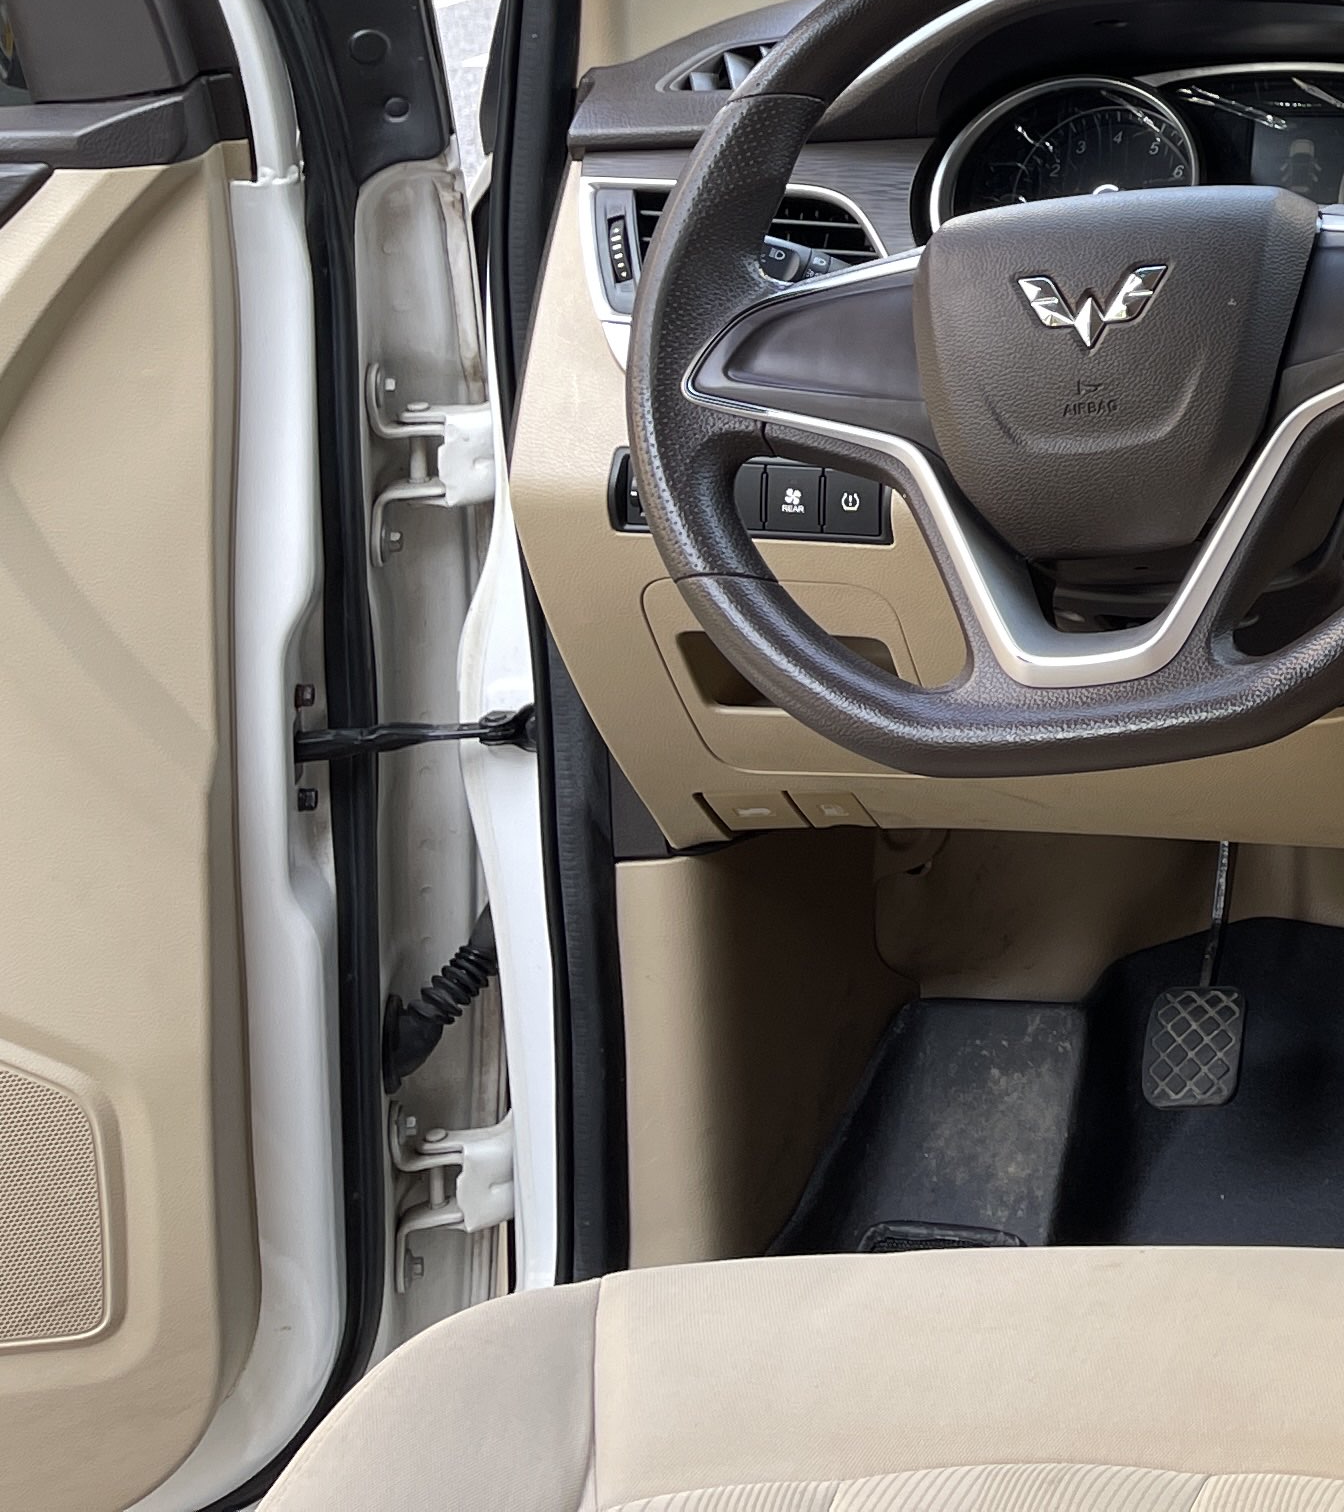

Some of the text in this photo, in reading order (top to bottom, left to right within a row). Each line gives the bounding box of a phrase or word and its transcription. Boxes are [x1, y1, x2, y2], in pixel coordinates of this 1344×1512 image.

[1075, 140, 1087, 154] 3
[1112, 130, 1124, 144] 4
[1149, 141, 1160, 155] 5
[1172, 164, 1185, 178] 6
[781, 504, 805, 514] REAR
